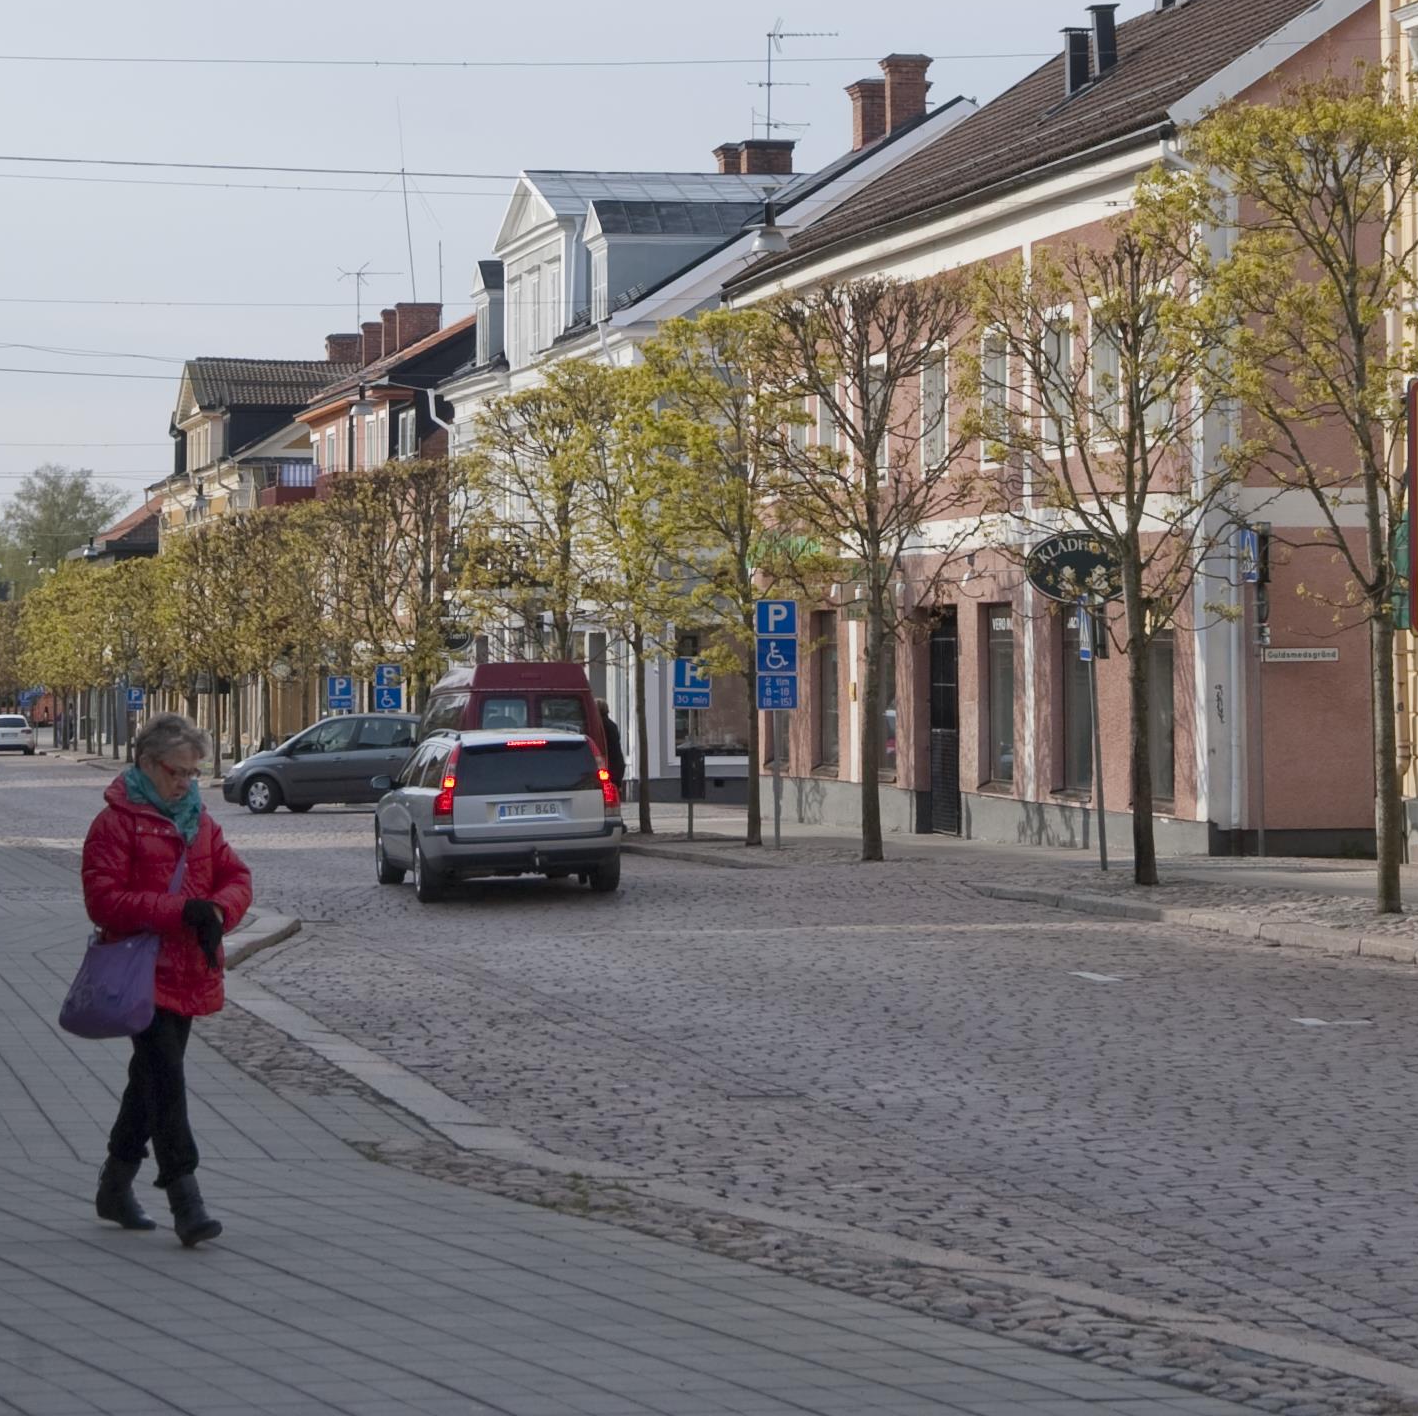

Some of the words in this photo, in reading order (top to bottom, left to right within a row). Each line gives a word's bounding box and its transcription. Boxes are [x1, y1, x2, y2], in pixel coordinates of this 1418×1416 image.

[768, 604, 788, 632] P
[334, 678, 347, 695] P
[131, 690, 140, 700] P
[676, 694, 689, 704] 30
[693, 695, 708, 705] min
